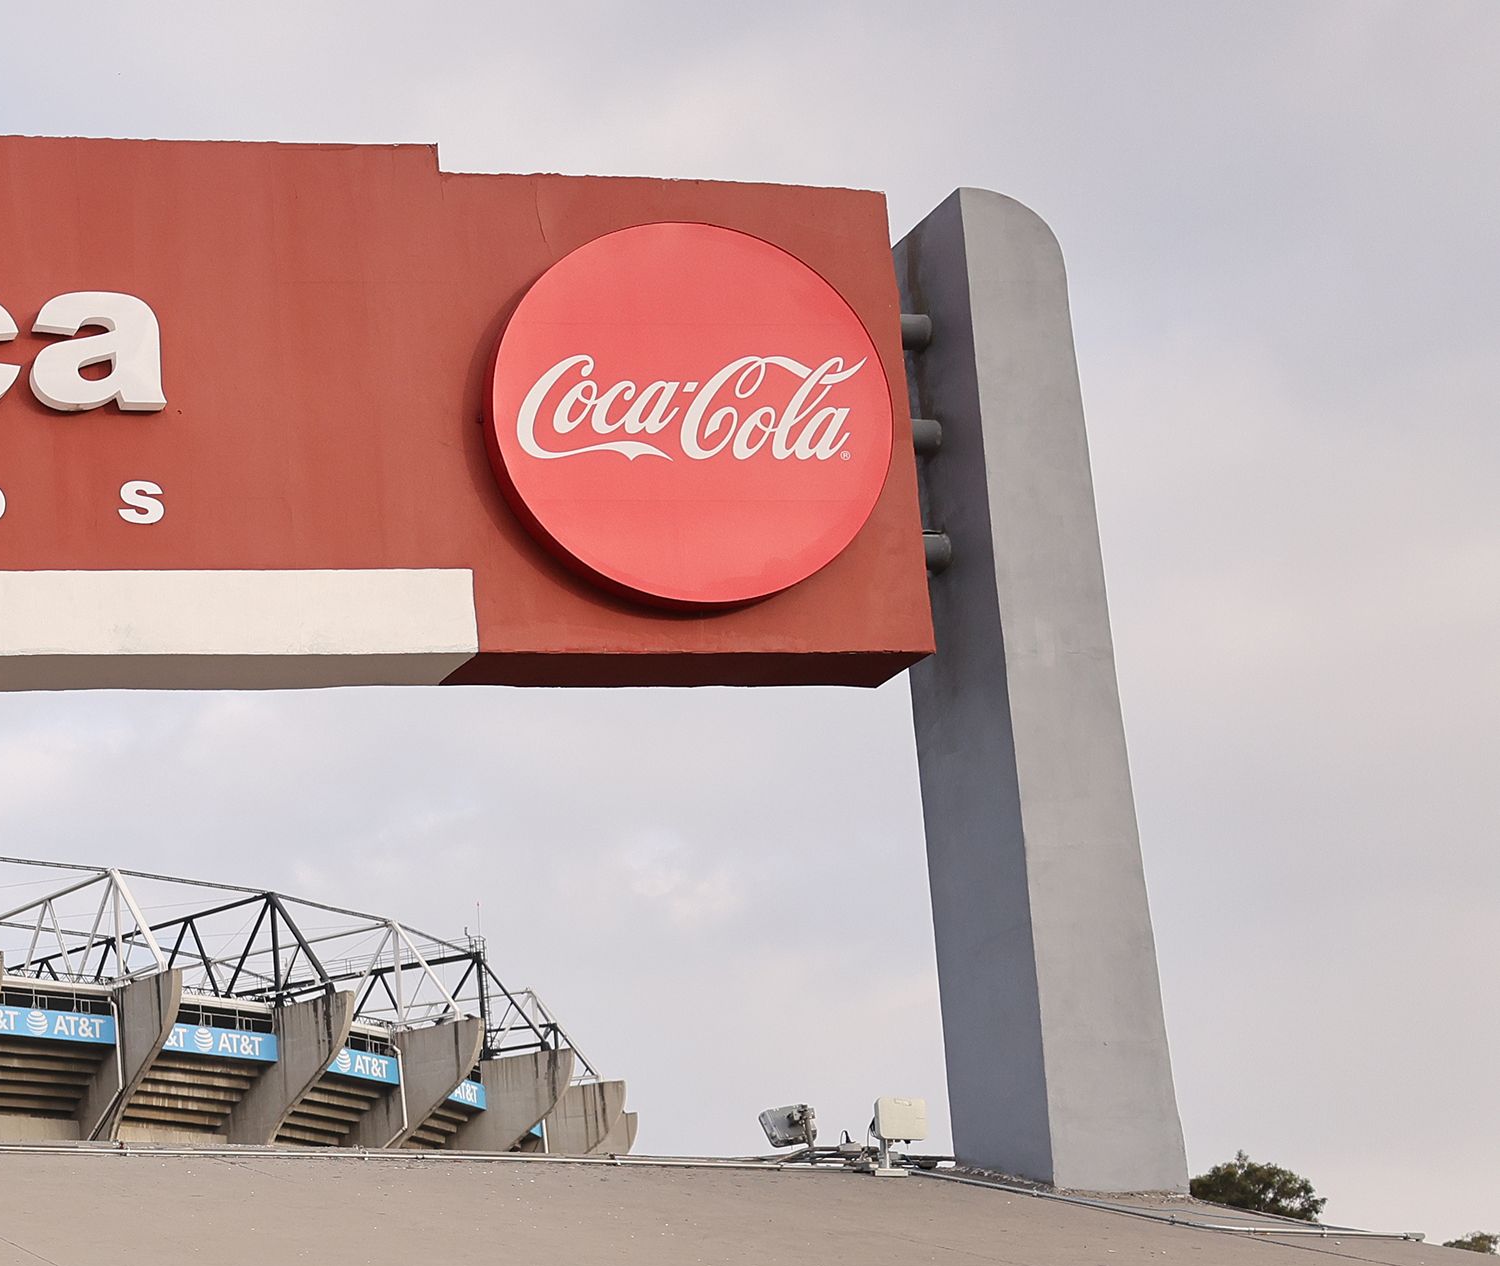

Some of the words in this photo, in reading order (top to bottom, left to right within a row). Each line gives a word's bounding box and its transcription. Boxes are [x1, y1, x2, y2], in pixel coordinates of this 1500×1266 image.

[516, 354, 867, 461] Coca-Cola
[53, 1016, 105, 1039] AT&T
[218, 1033, 264, 1057] AT&T
[354, 1054, 388, 1079] AT&T
